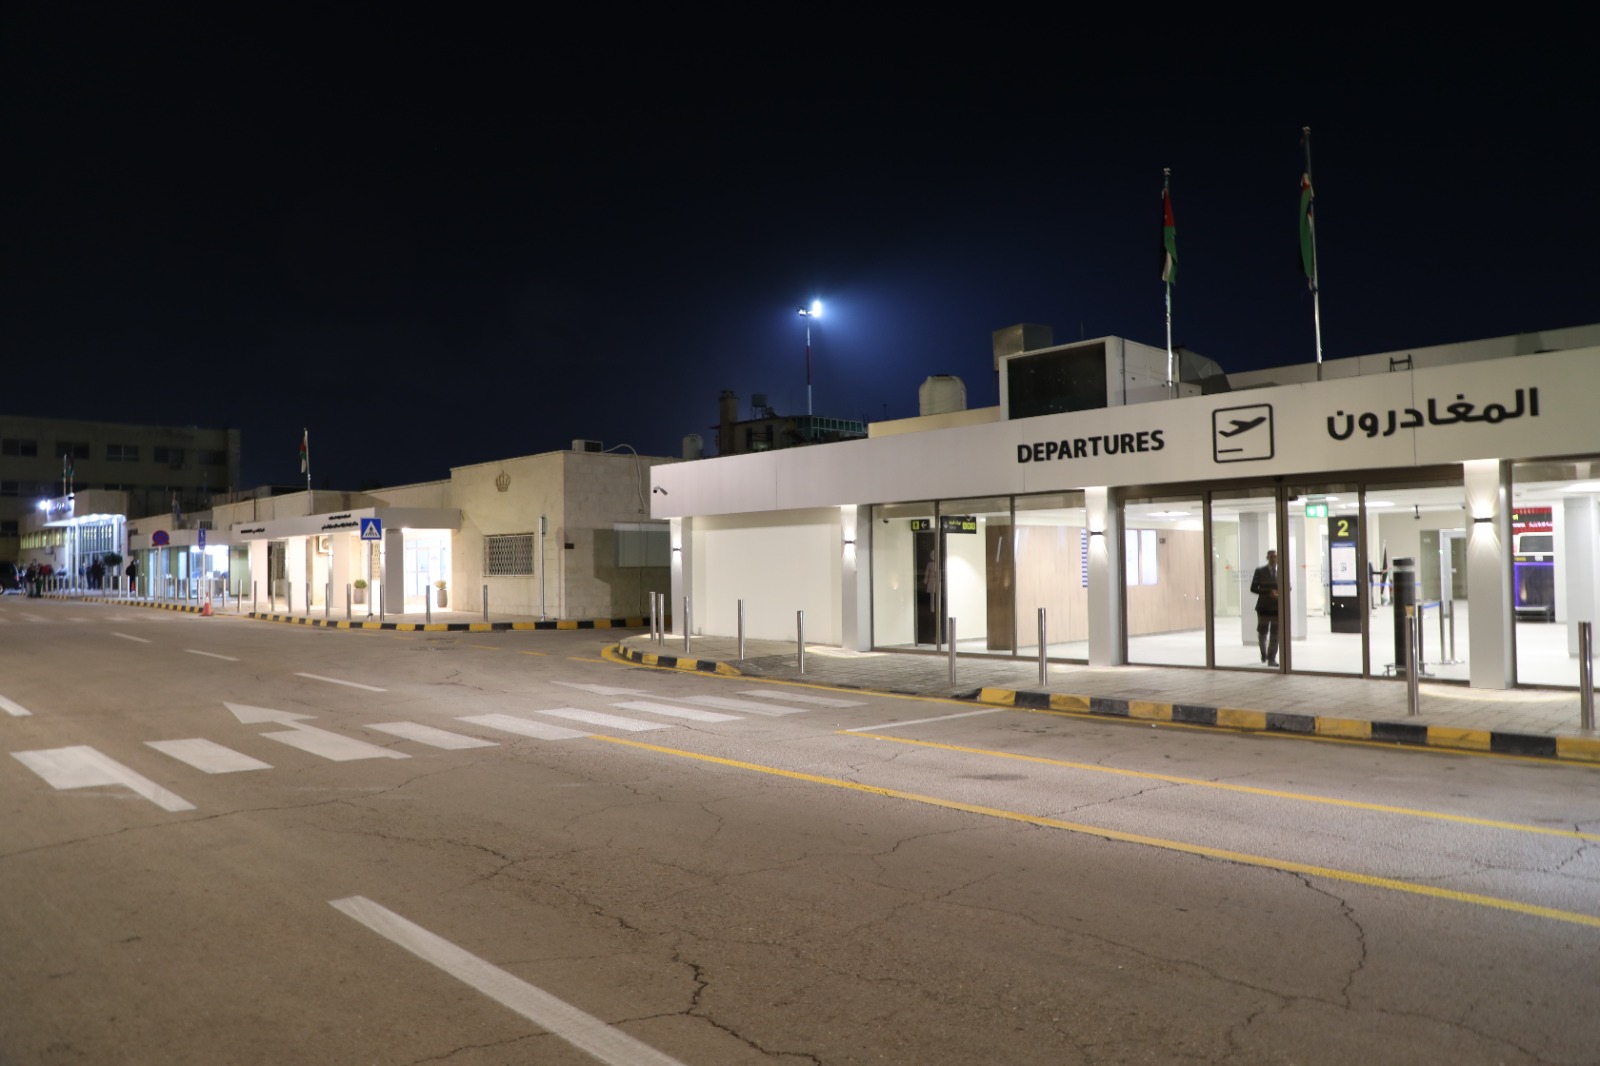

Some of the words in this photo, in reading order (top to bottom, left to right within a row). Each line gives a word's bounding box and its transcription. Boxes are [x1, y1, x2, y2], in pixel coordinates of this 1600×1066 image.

[1327, 387, 1540, 440] المغادرون
[1017, 430, 1165, 464] DEPARTURES
[1337, 519, 1349, 537] 2
